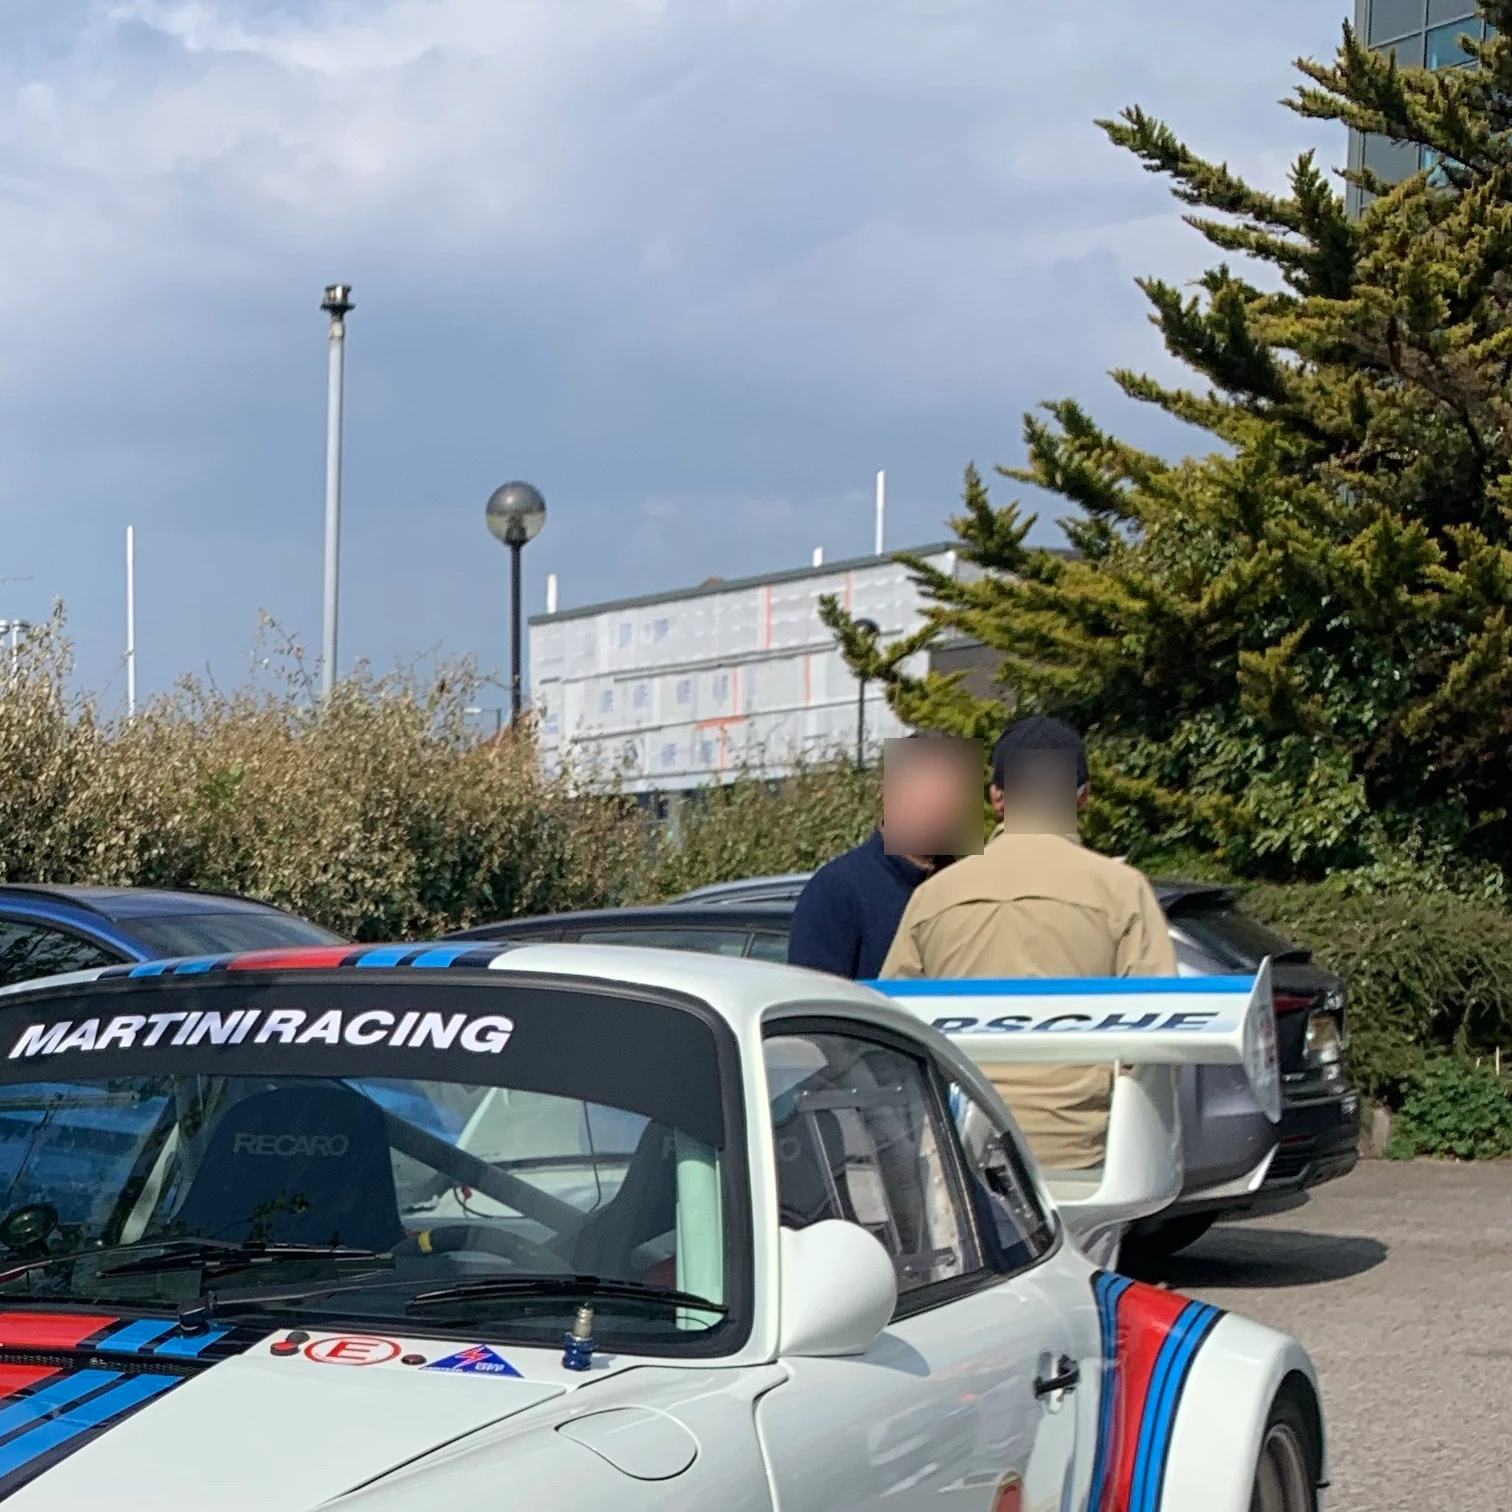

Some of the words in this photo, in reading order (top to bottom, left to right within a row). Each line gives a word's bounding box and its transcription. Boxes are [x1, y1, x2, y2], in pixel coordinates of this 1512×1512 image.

[930, 1012, 1220, 1032] RSCHE
[232, 1132, 350, 1157] RECARO
[326, 1340, 380, 1360] E
